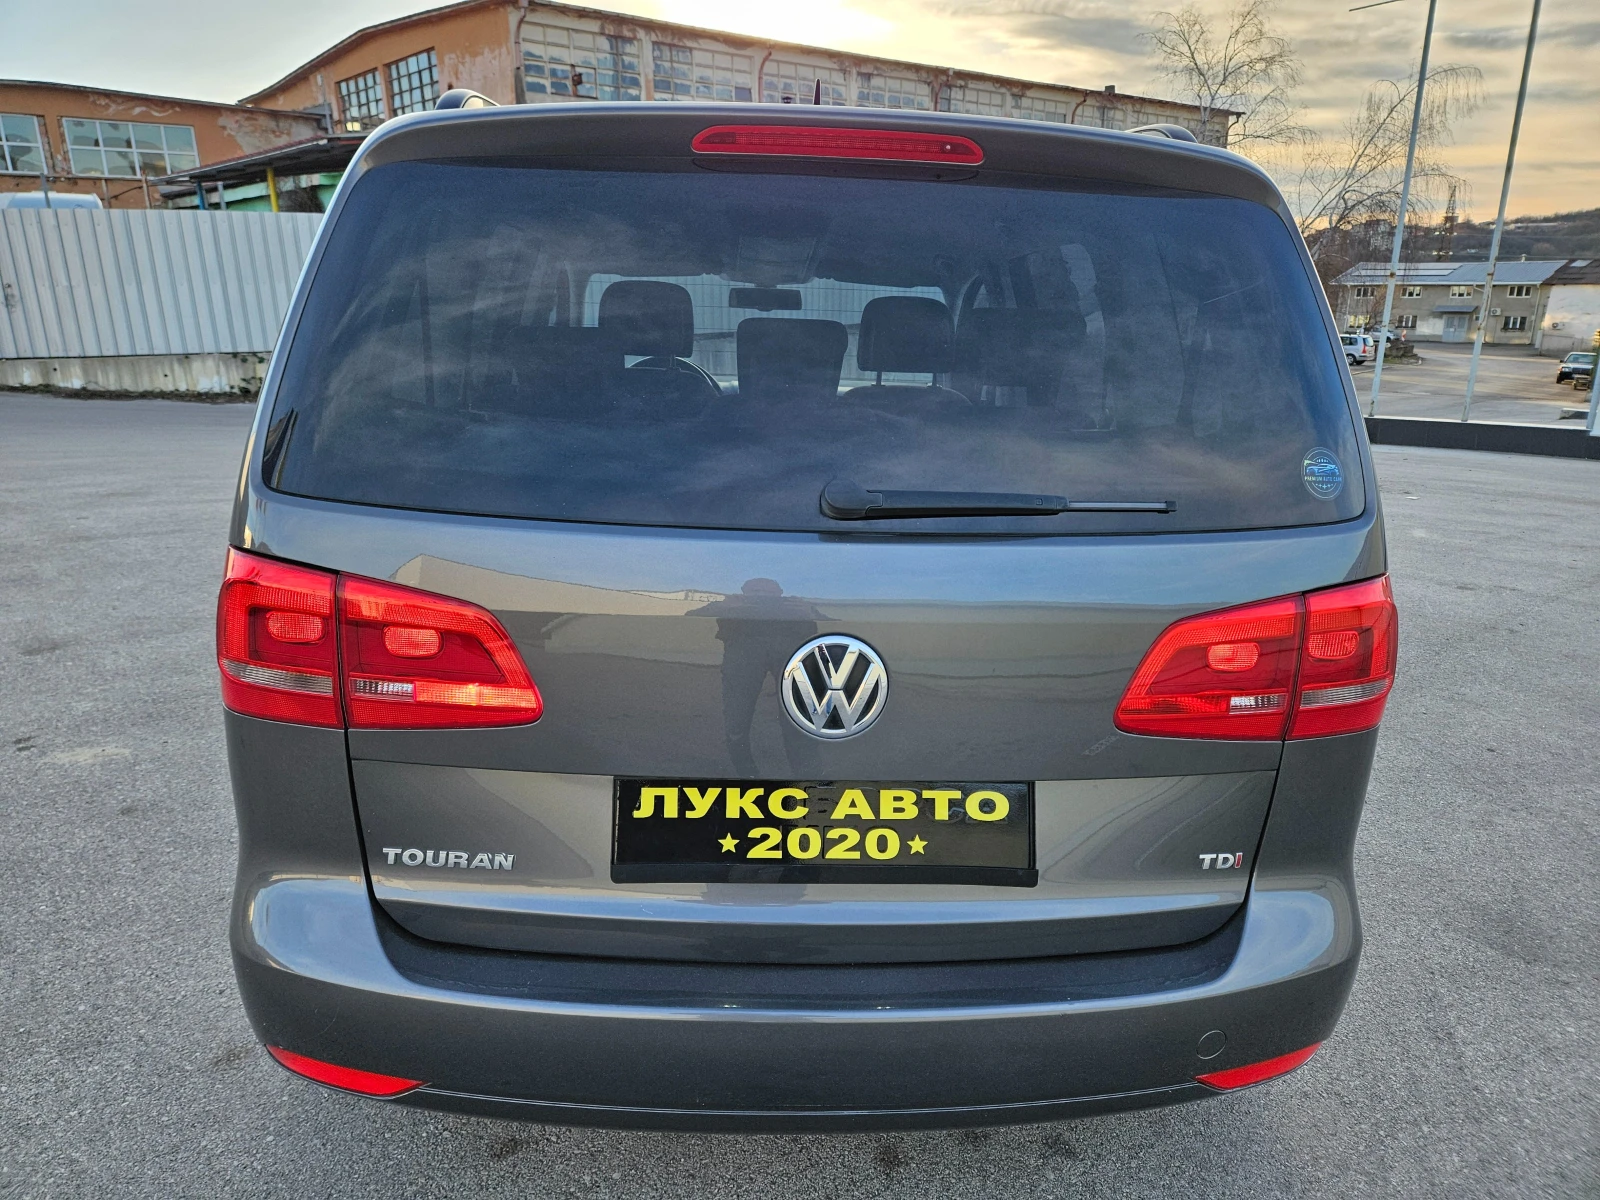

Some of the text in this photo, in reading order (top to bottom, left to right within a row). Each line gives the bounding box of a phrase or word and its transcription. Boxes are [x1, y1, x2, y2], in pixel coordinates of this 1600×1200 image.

[788, 640, 883, 735] VW
[632, 787, 1009, 822] ЛУКС АВТО
[382, 847, 516, 871] TOURAN
[746, 826, 901, 860] 2020
[1199, 852, 1243, 870] TDI
